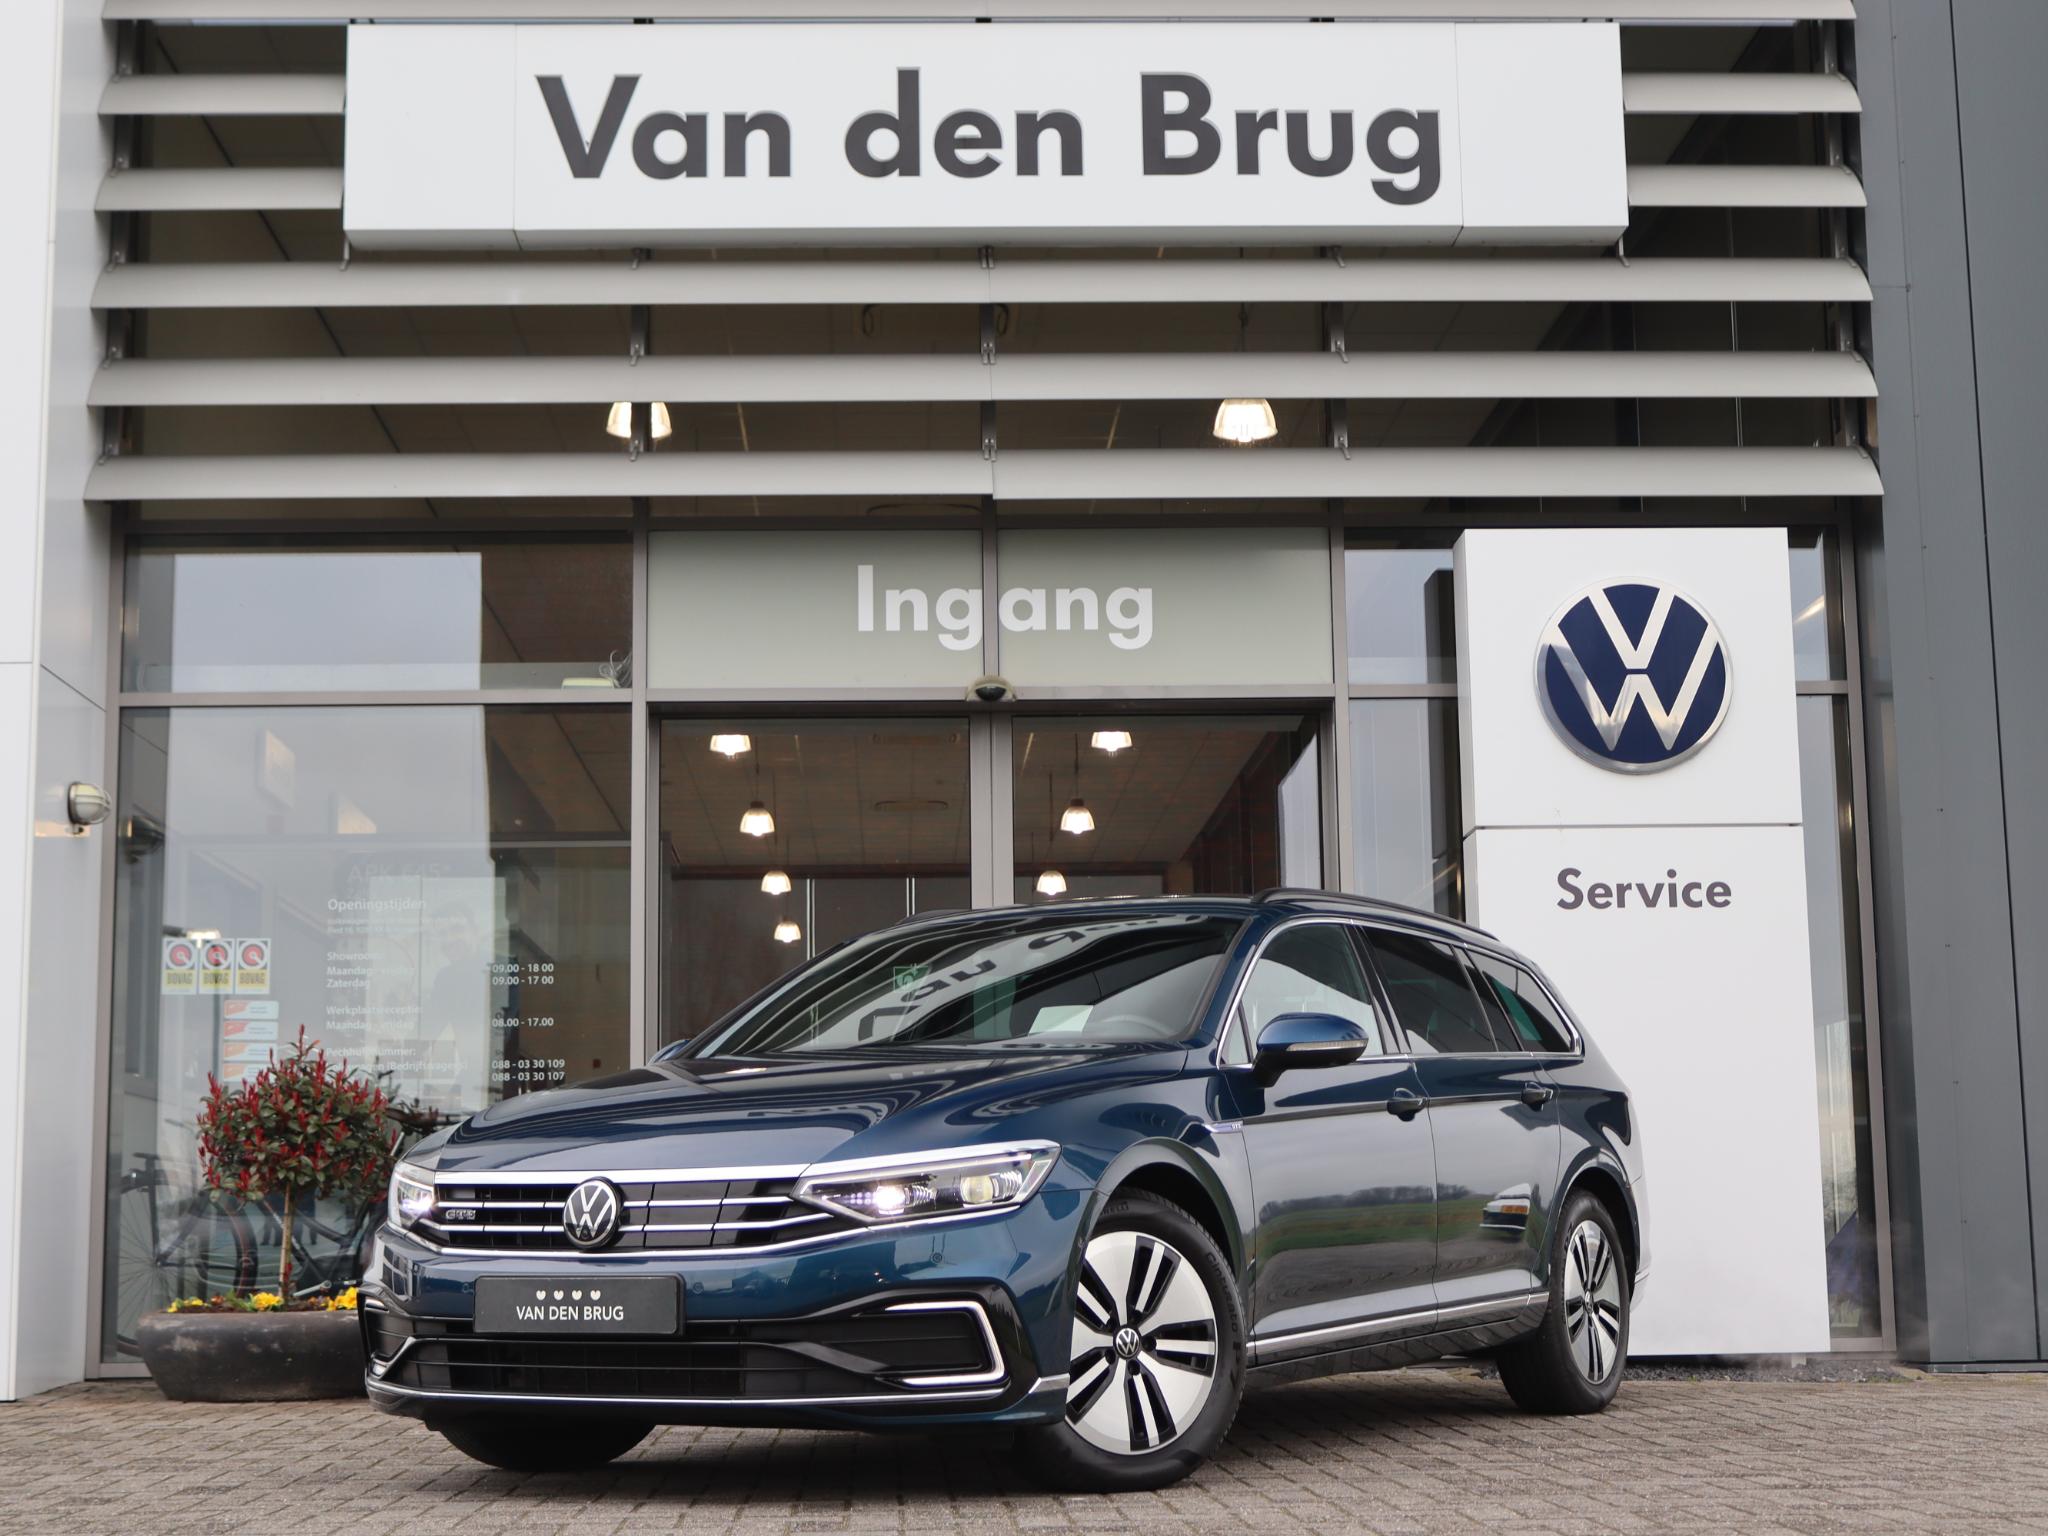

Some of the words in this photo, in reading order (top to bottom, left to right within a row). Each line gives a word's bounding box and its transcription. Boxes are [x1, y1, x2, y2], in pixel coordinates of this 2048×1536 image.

[535, 74, 792, 181] Van
[843, 67, 1085, 181] den
[1140, 71, 1442, 207] Brug
[857, 564, 1154, 652] Ingang
[1556, 866, 1733, 911] Service
[327, 898, 427, 913] Openingstijden
[491, 963, 520, 973] 09.00
[325, 977, 371, 990] Zaterdag
[491, 975, 520, 985] 09.00
[491, 1018, 520, 1028] 08.00
[527, 1017, 555, 1027] 17.00
[491, 1060, 511, 1070] 088
[517, 1060, 530, 1070] 03
[532, 1060, 545, 1069] 30
[547, 1059, 566, 1069] 109
[491, 1073, 511, 1082] 088
[517, 1072, 530, 1081] 03
[532, 1072, 545, 1081] 30
[547, 1071, 566, 1081] 107
[515, 1305, 546, 1322] VAN
[548, 1305, 580, 1322] DEN
[583, 1304, 625, 1322] BRUG
